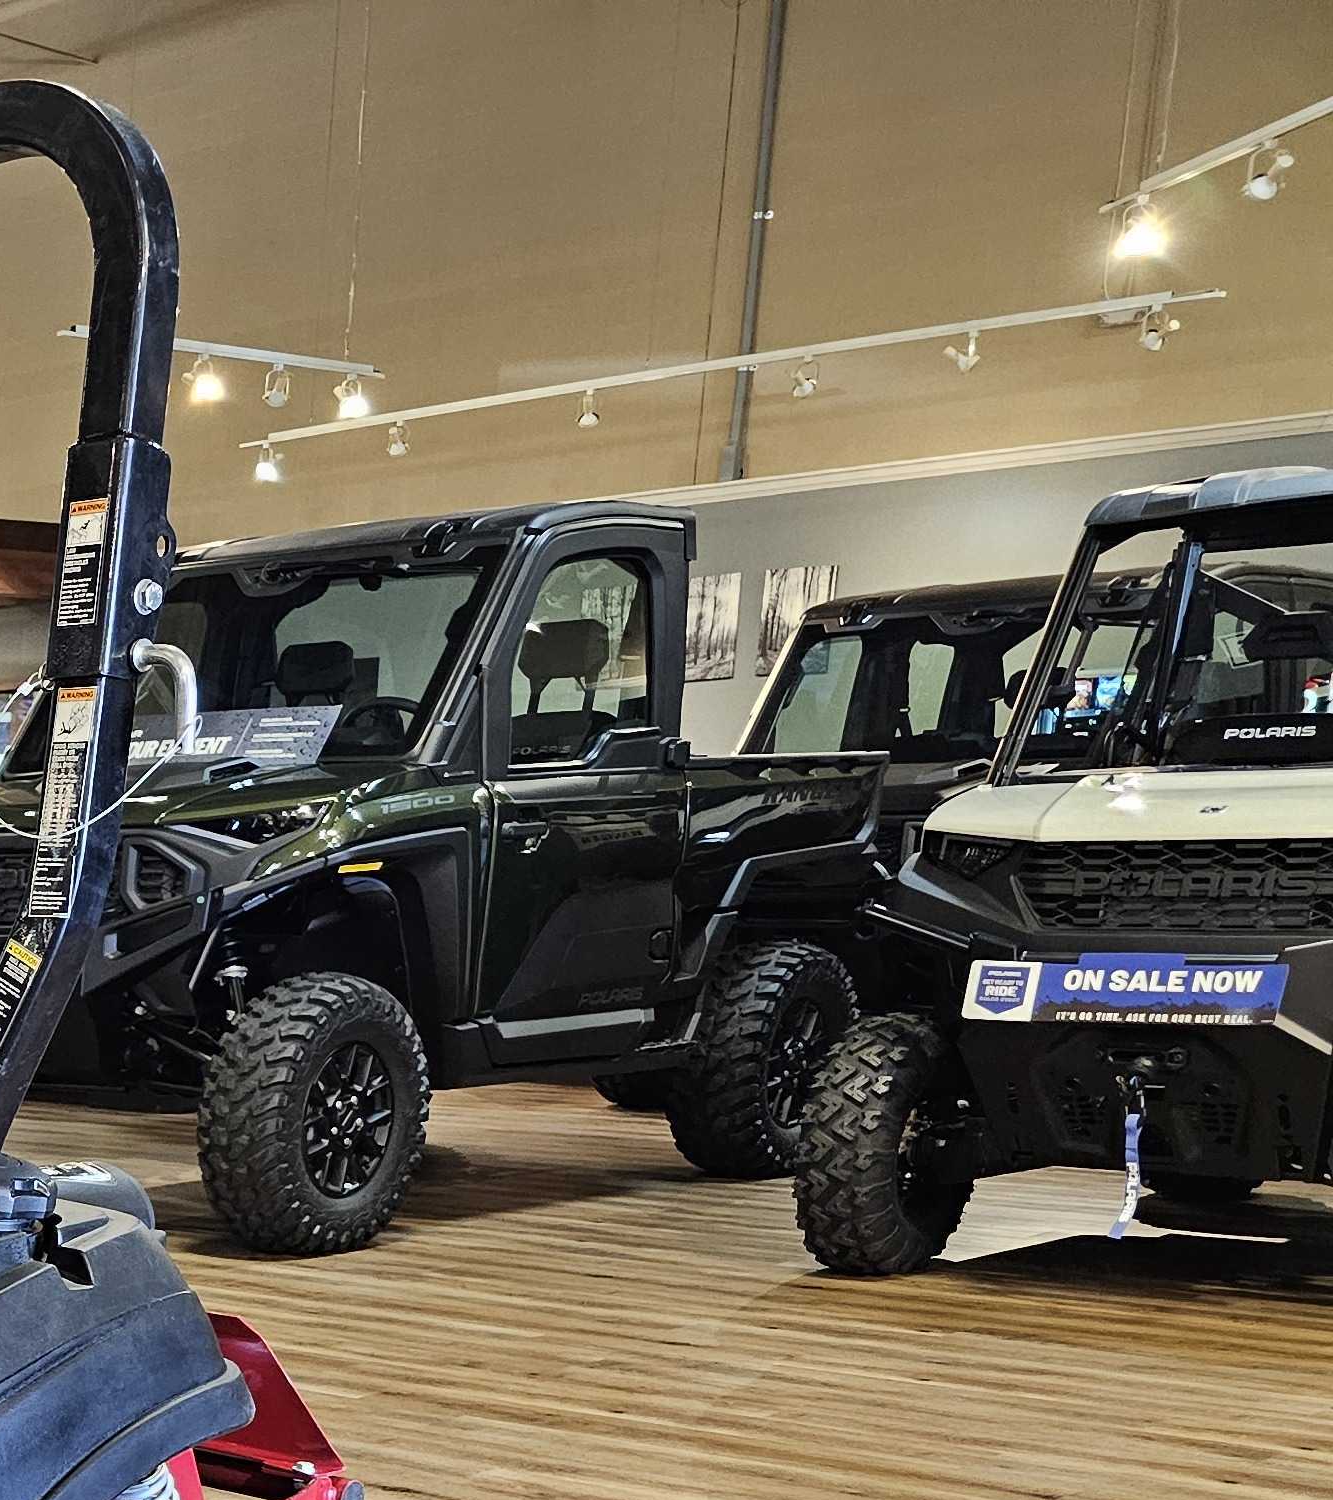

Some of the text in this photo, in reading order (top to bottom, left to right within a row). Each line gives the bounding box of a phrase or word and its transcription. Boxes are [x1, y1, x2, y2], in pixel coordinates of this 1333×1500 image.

[77, 502, 105, 512] WARNING
[66, 690, 94, 699] WARNING
[1223, 725, 1317, 740] POLARIS
[1073, 870, 1319, 897] POLARIS
[13, 945, 38, 966] CAUTION
[1064, 970, 1264, 992] ON SALE NOW
[985, 985, 1018, 998] RIDE
[1055, 1011, 1077, 1020] IT'S
[1148, 1013, 1168, 1023] FOR
